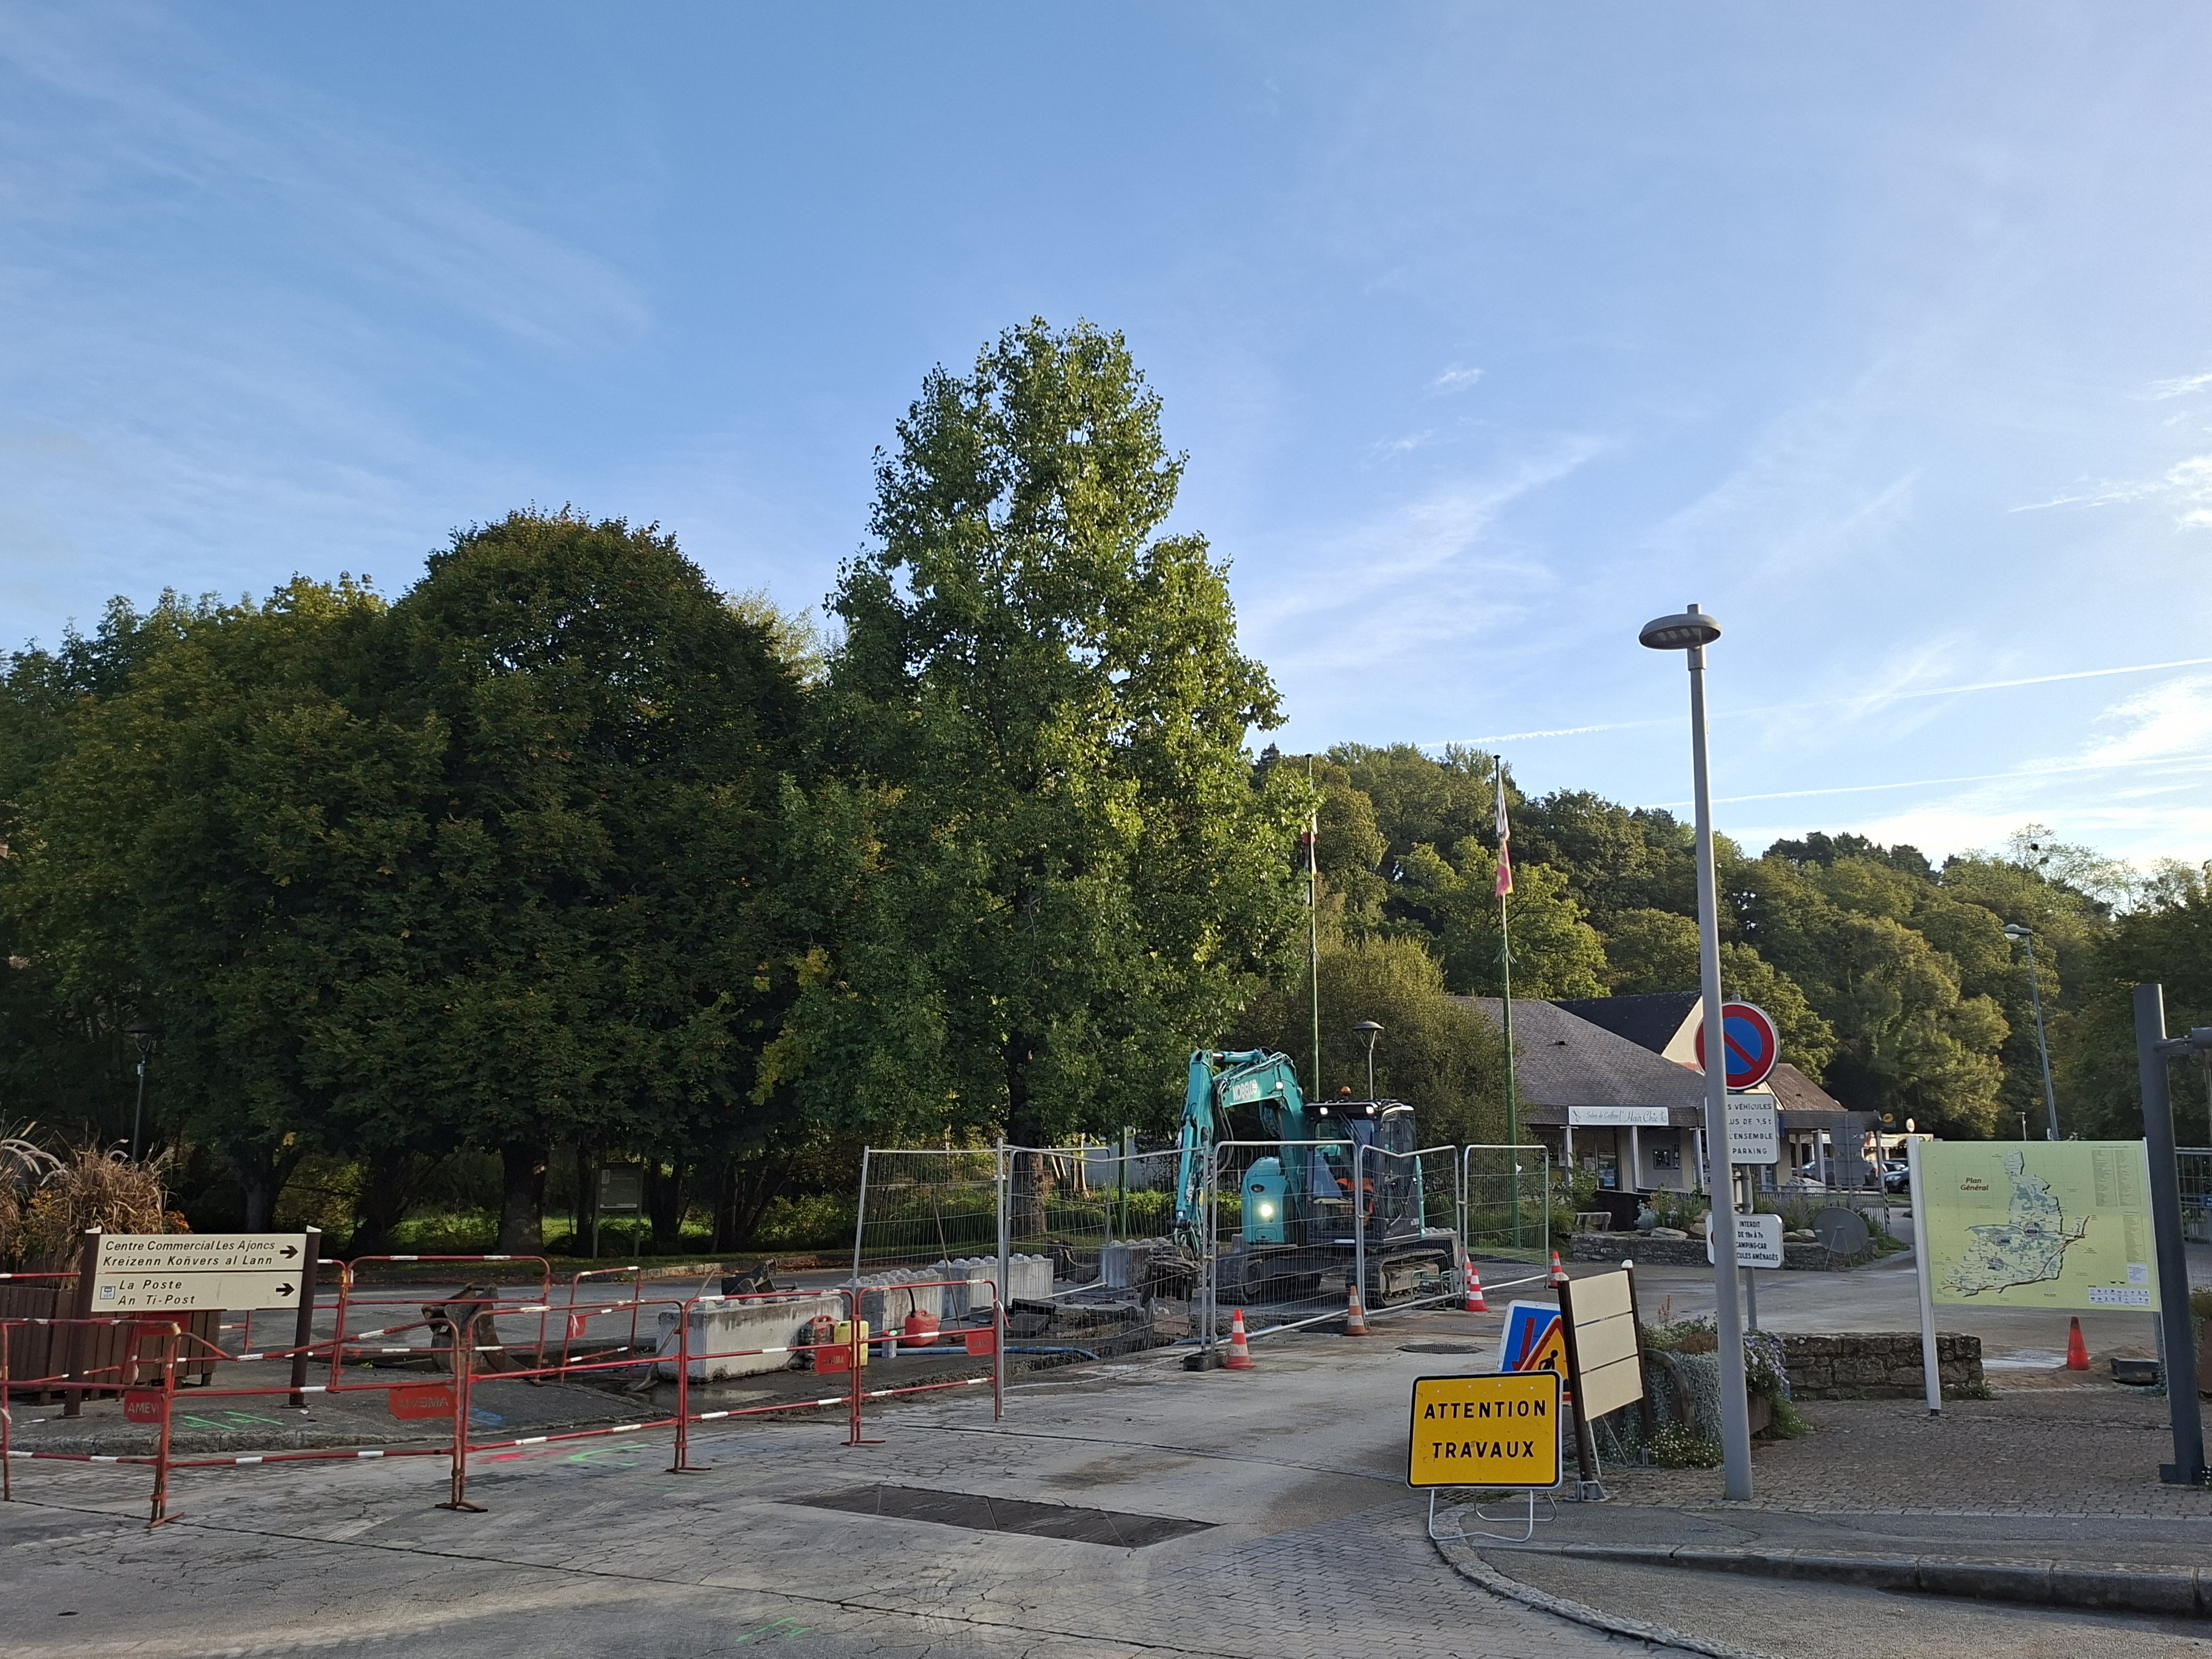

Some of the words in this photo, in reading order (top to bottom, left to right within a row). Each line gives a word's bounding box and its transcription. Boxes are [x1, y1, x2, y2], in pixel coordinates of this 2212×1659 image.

[1233, 1079, 1258, 1102] KOBELCO
[1643, 1110, 1658, 1122] Chic
[106, 1240, 144, 1250] Centre
[147, 1240, 215, 1250] Commercial
[216, 1240, 235, 1250] Les
[237, 1240, 275, 1253] Ajoncs
[103, 1256, 161, 1266] Kreizenn
[167, 1255, 219, 1266] Koñvers
[225, 1255, 238, 1265] al
[242, 1255, 272, 1265] Lann
[119, 1280, 134, 1290] La
[143, 1280, 182, 1290] Poste
[118, 1295, 135, 1306] An
[146, 1295, 195, 1305] Ti-Post
[127, 1402, 160, 1414] AMEVI
[1423, 1400, 1546, 1420] ATTENTION
[1432, 1441, 1535, 1458] TRAVAUX
